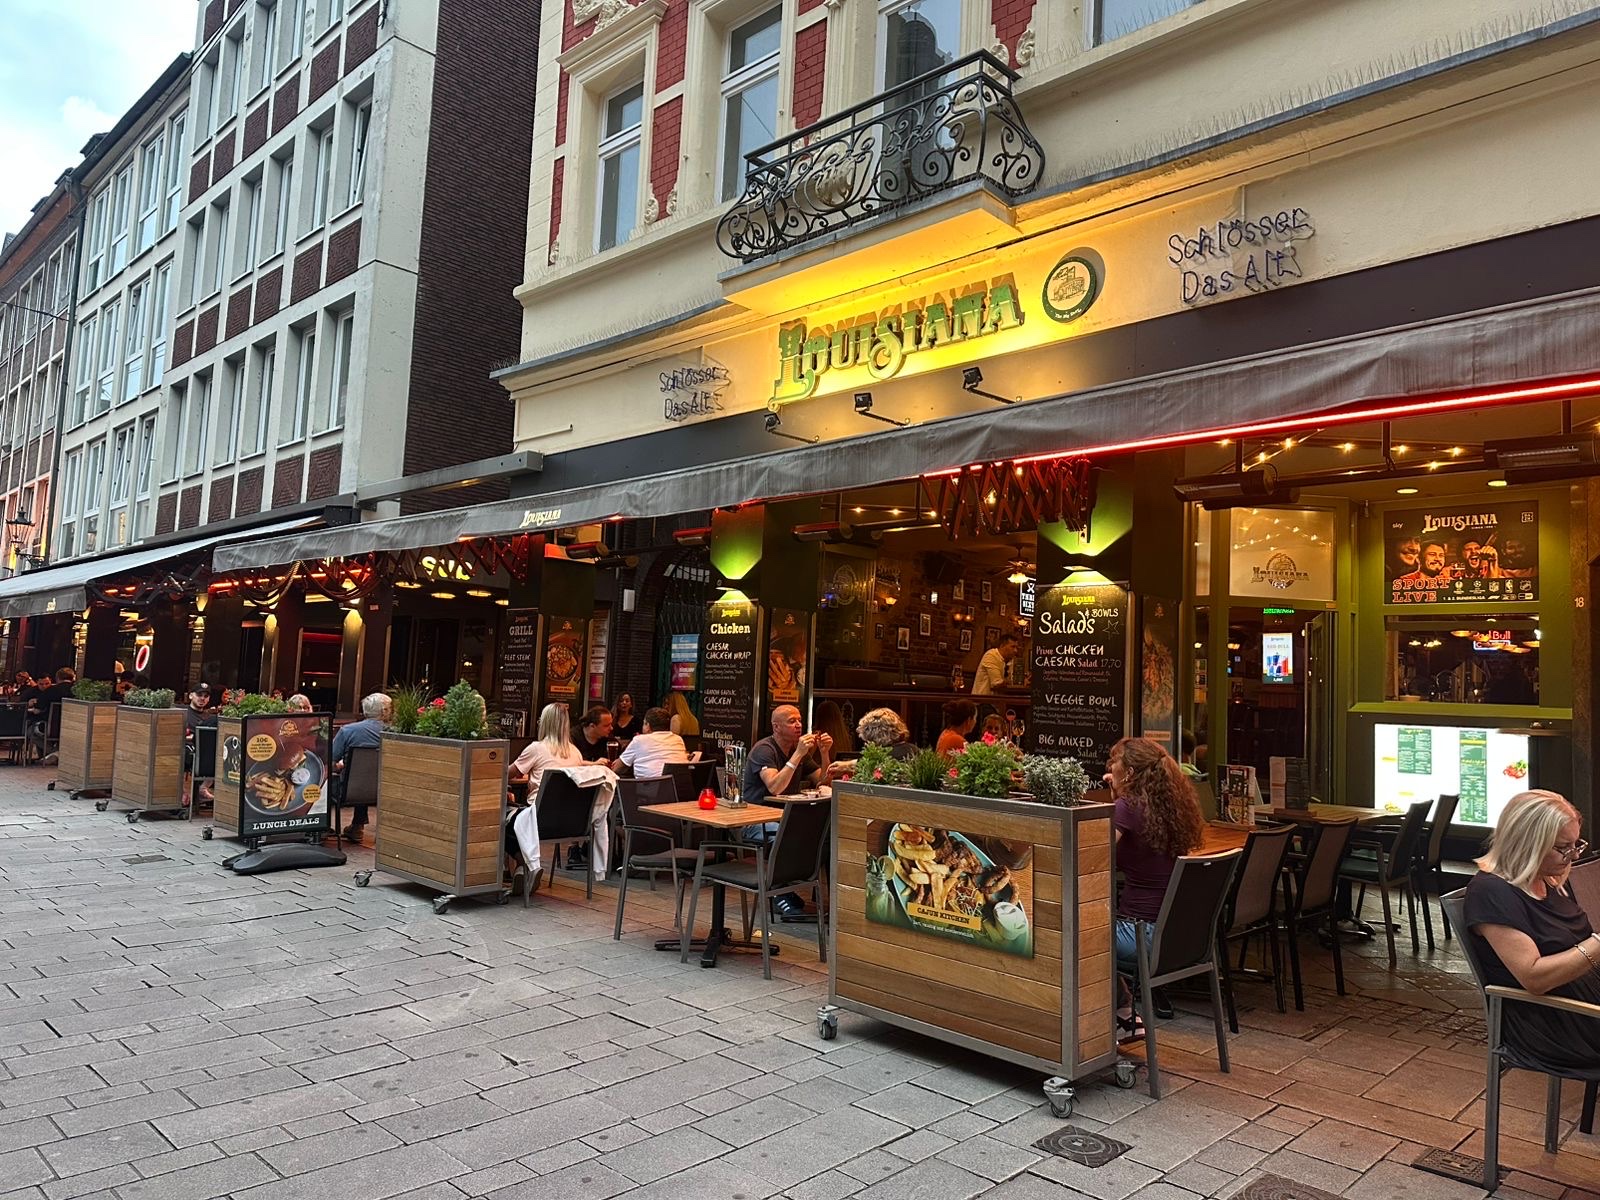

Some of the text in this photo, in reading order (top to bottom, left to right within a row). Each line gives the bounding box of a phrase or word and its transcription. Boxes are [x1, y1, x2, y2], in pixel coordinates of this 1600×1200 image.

[1168, 208, 1310, 264] Schlösser
[1183, 249, 1293, 303] Das Alt
[664, 398, 688, 419] Das
[1392, 577, 1450, 591] SPORT
[1392, 591, 1437, 603] LIVE
[1574, 597, 1585, 608] 18
[1091, 608, 1119, 618] BOWLS
[710, 622, 751, 635] Chicken
[1039, 610, 1096, 635] Salads
[509, 625, 534, 636] GRILL
[1492, 630, 1511, 640] Bull
[706, 642, 730, 652] CAESAR
[705, 651, 752, 661] CHICKEN WRAP
[1035, 656, 1076, 668] CAESAR
[1077, 658, 1098, 668] Salad
[1089, 695, 1118, 707] BOWL
[1077, 747, 1098, 758] Salad
[252, 817, 320, 830] LUNCH DEALS
[917, 907, 970, 924] CAJUN KITCHEN
